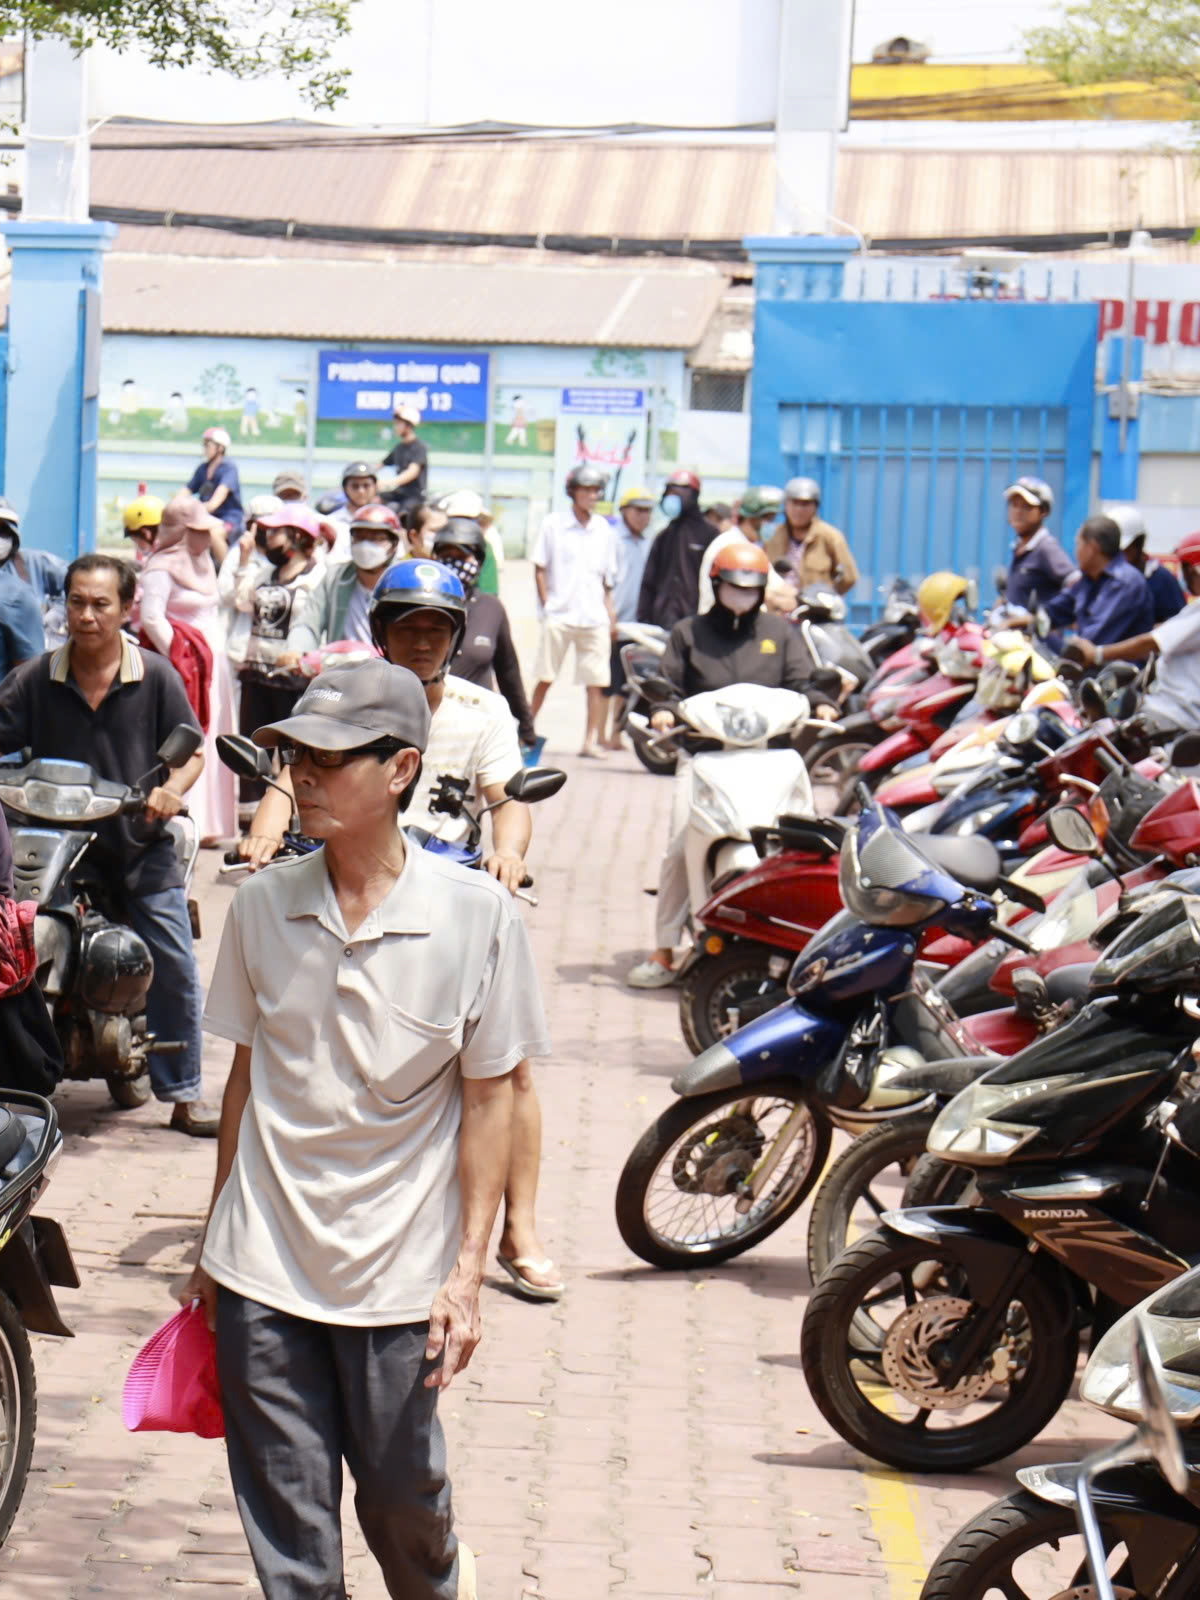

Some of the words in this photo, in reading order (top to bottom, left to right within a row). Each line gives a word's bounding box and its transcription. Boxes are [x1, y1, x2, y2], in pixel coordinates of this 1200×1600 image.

[356, 390, 392, 411] KHU
[431, 392, 453, 412] 13
[1023, 1208, 1089, 1219] HONDA
